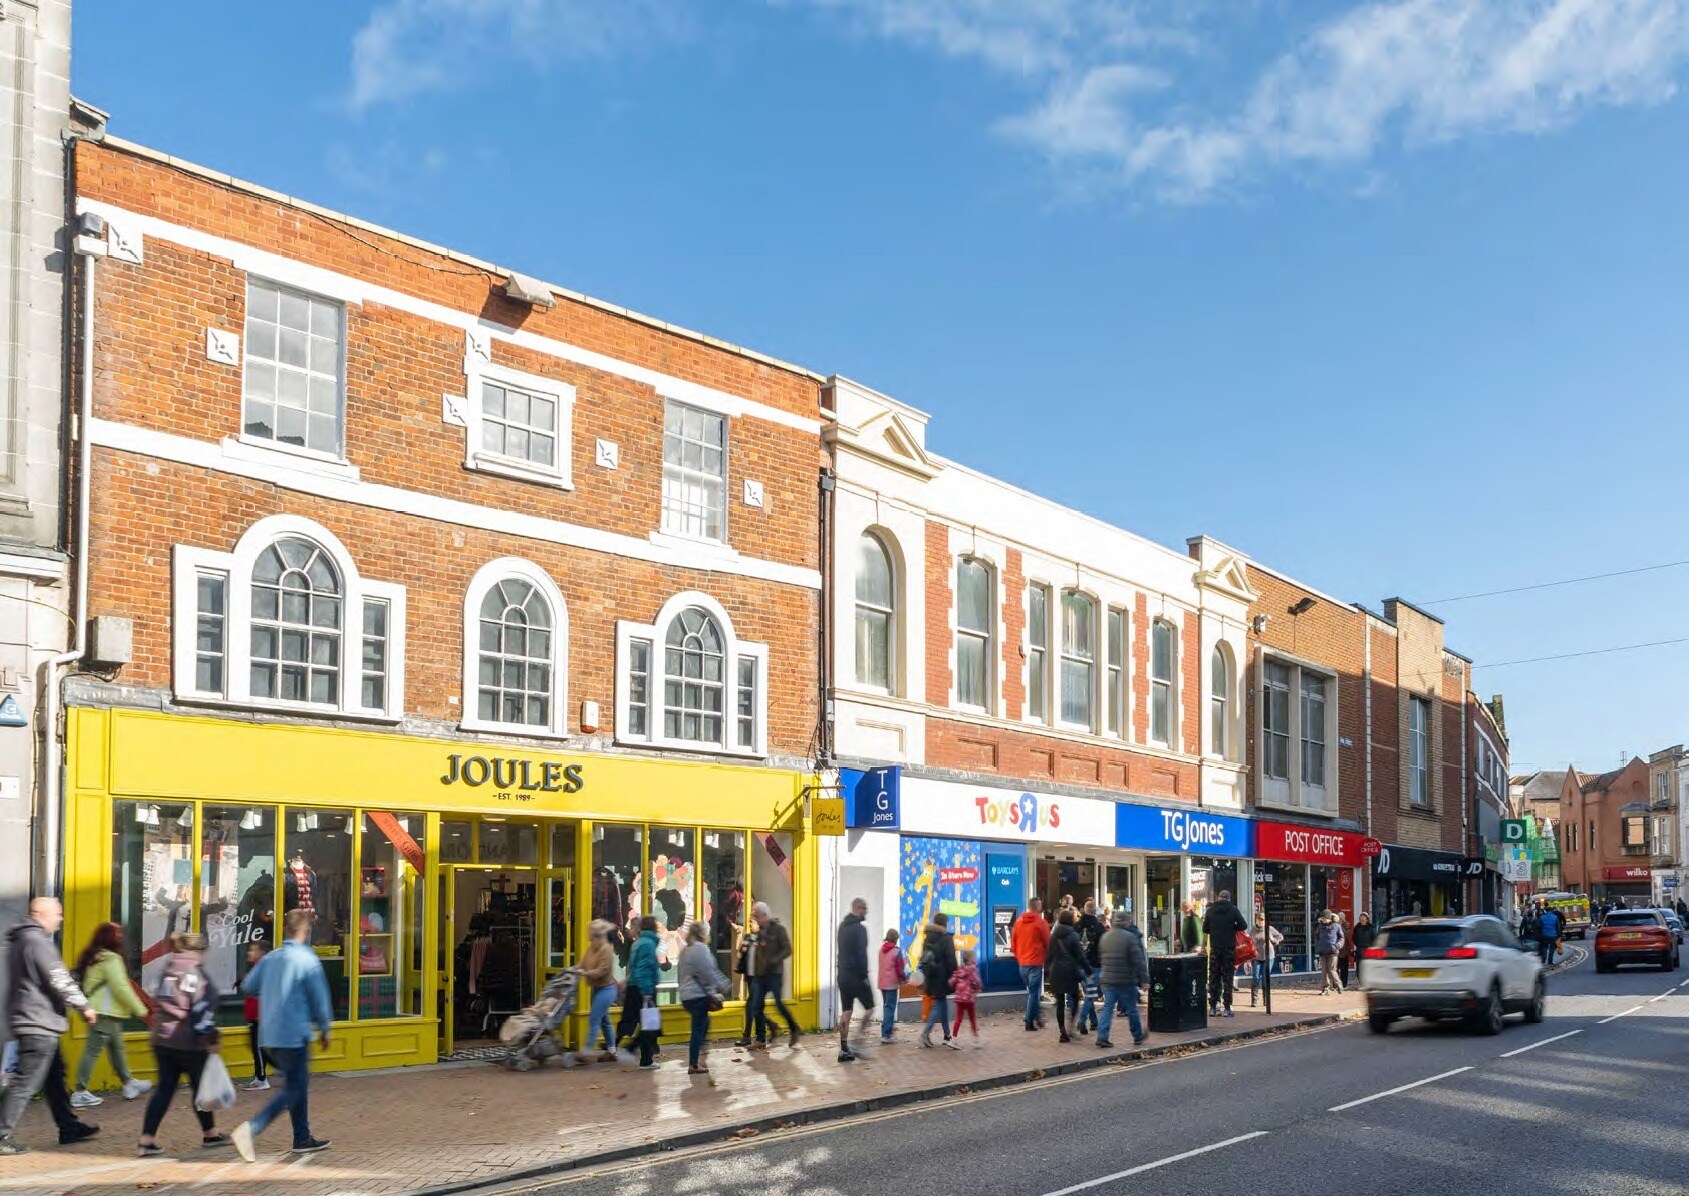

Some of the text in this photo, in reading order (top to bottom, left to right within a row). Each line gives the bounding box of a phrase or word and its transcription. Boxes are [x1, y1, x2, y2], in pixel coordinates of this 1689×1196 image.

[440, 754, 584, 793] JOULES
[877, 770, 888, 788] T
[877, 791, 888, 810] G
[872, 812, 893, 824] Jones
[1507, 823, 1523, 839] D
[1285, 830, 1344, 856] POST OFFICE
[1377, 848, 1390, 874] JD
[1466, 863, 1482, 874] JD
[996, 866, 1019, 875] BARCLAYS
[1626, 868, 1648, 876] wilko
[222, 908, 255, 927] Cool
[209, 923, 264, 949] Yule
